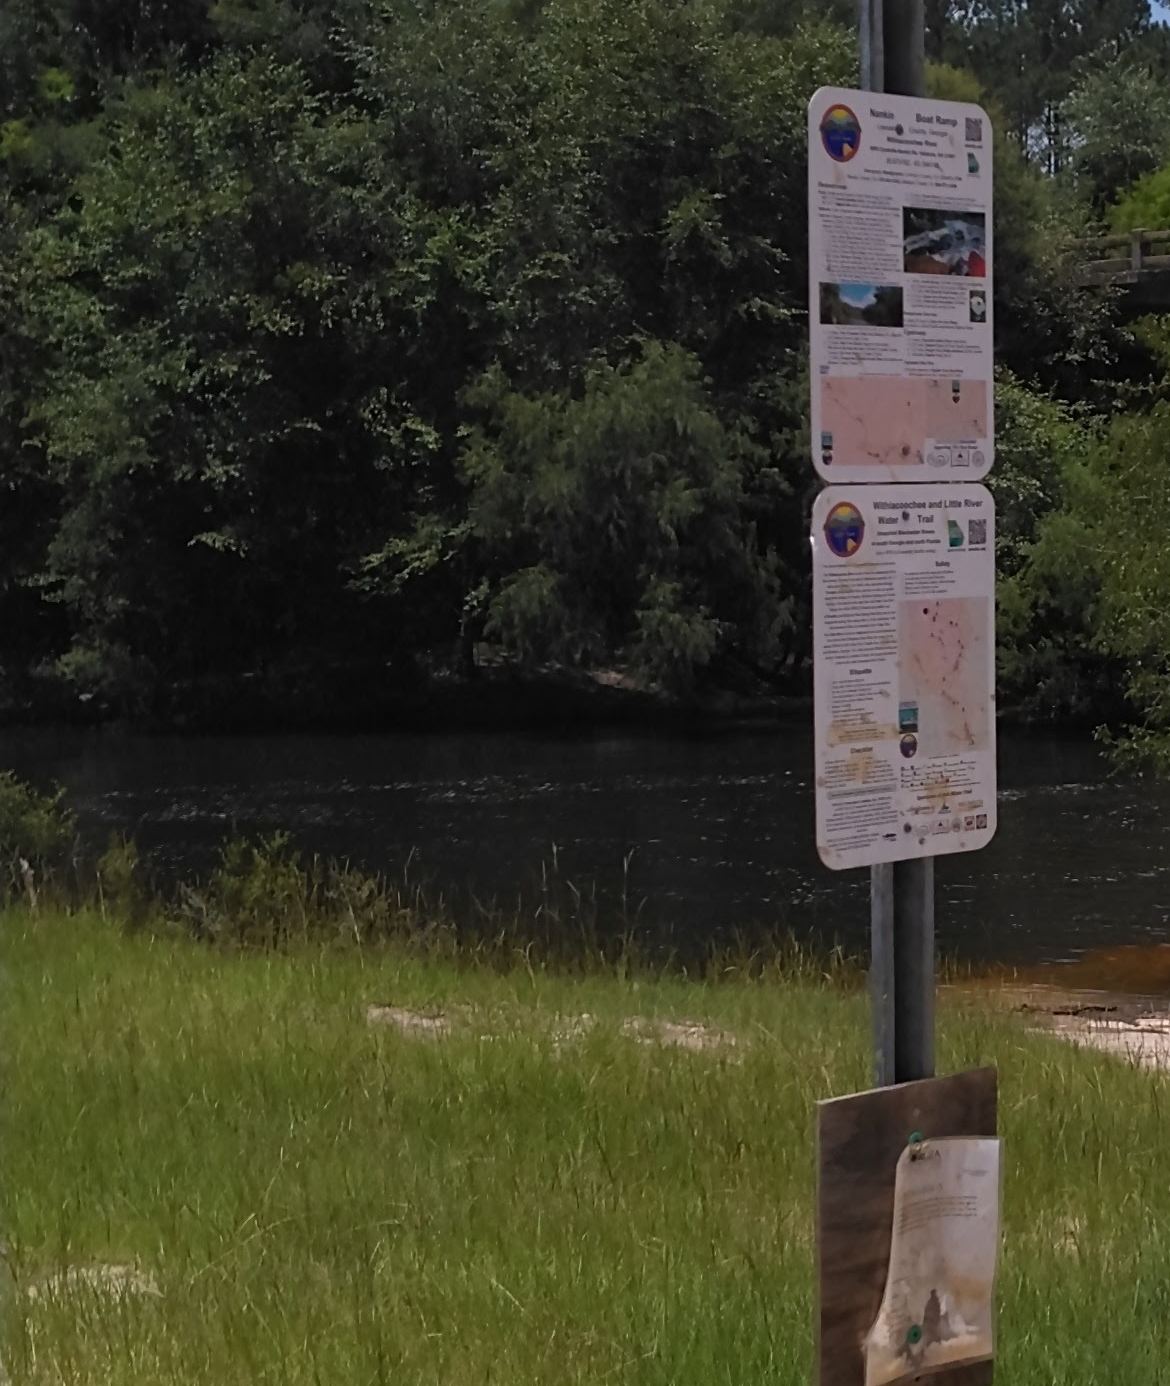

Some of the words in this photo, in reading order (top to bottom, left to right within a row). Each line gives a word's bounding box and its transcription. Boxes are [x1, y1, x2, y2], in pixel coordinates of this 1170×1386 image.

[916, 113, 933, 124] Boat
[936, 115, 958, 127] Ramp
[928, 499, 942, 508] and
[944, 499, 962, 508] Little
[964, 498, 983, 507] River
[878, 516, 899, 524] Water
[917, 514, 934, 523] Trail
